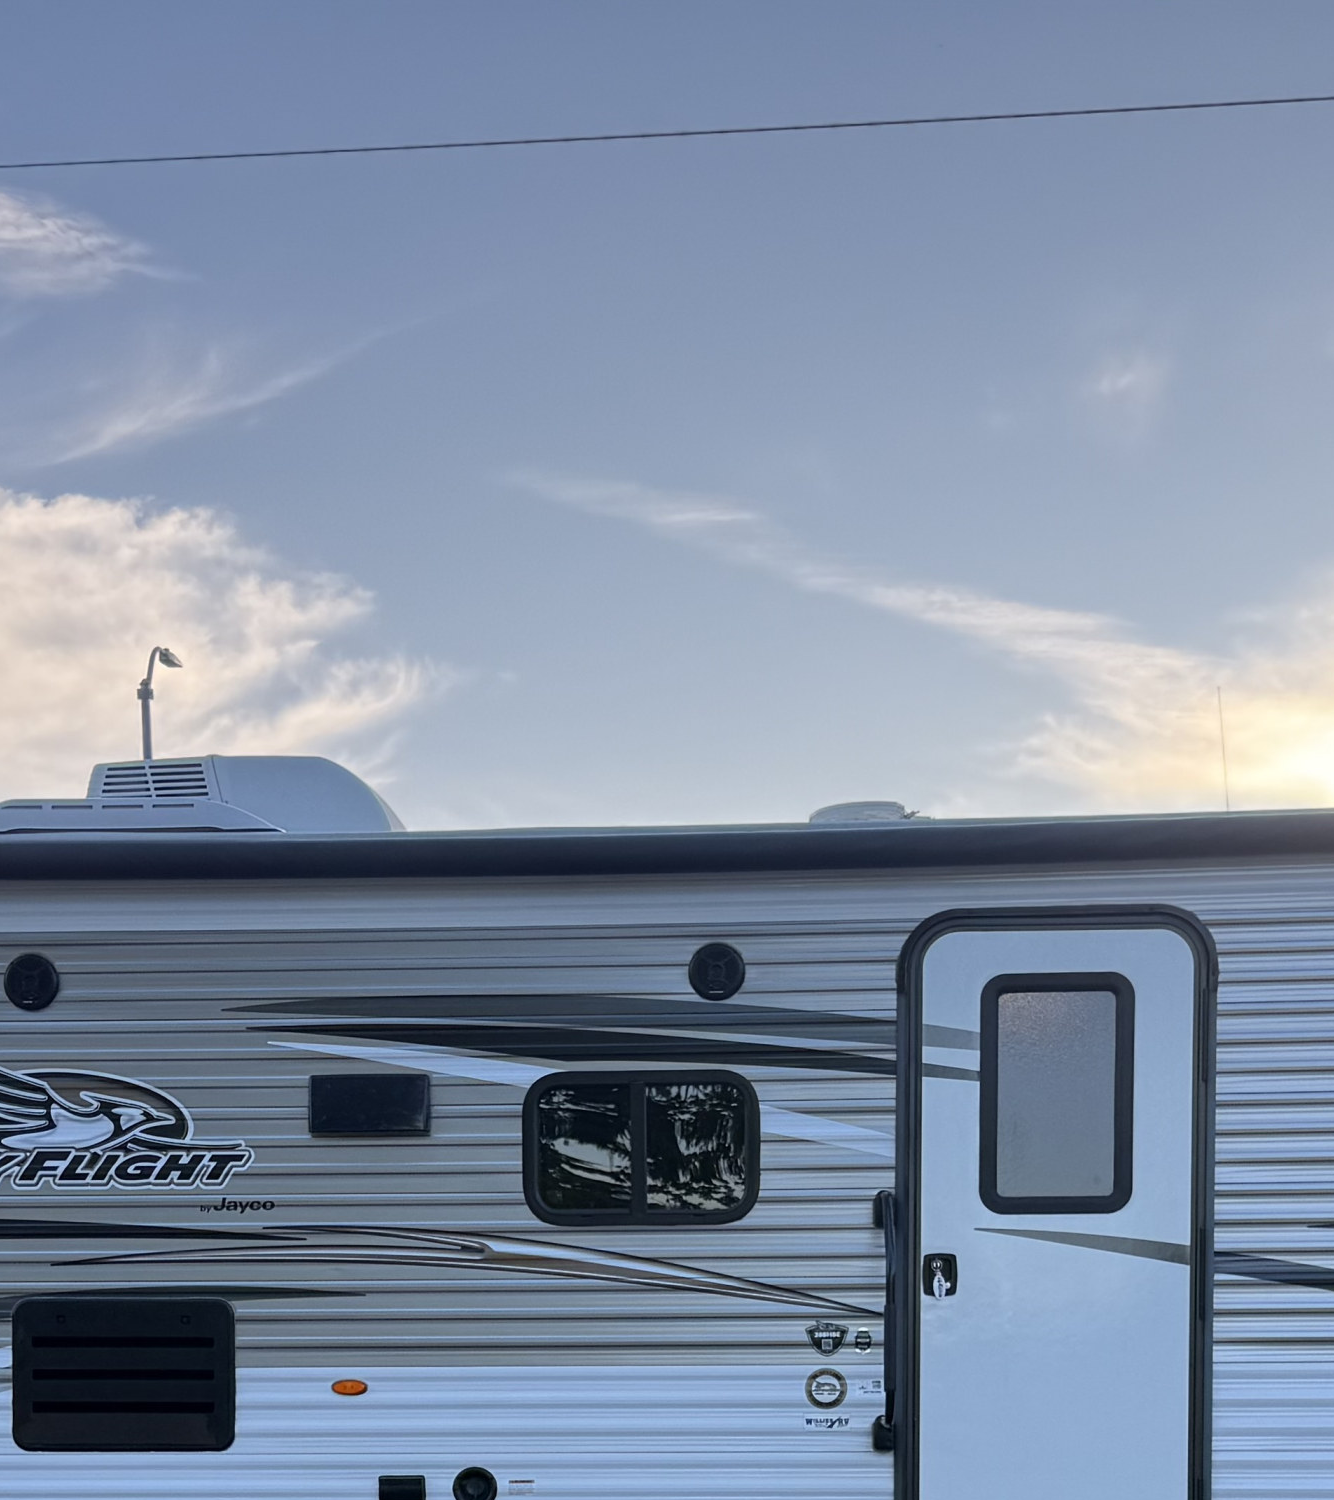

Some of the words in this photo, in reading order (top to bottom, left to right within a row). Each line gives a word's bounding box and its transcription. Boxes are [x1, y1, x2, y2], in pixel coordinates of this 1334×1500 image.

[13, 1146, 254, 1190] FLIGHT
[200, 1205, 211, 1213] by
[213, 1197, 275, 1214] Jayco
